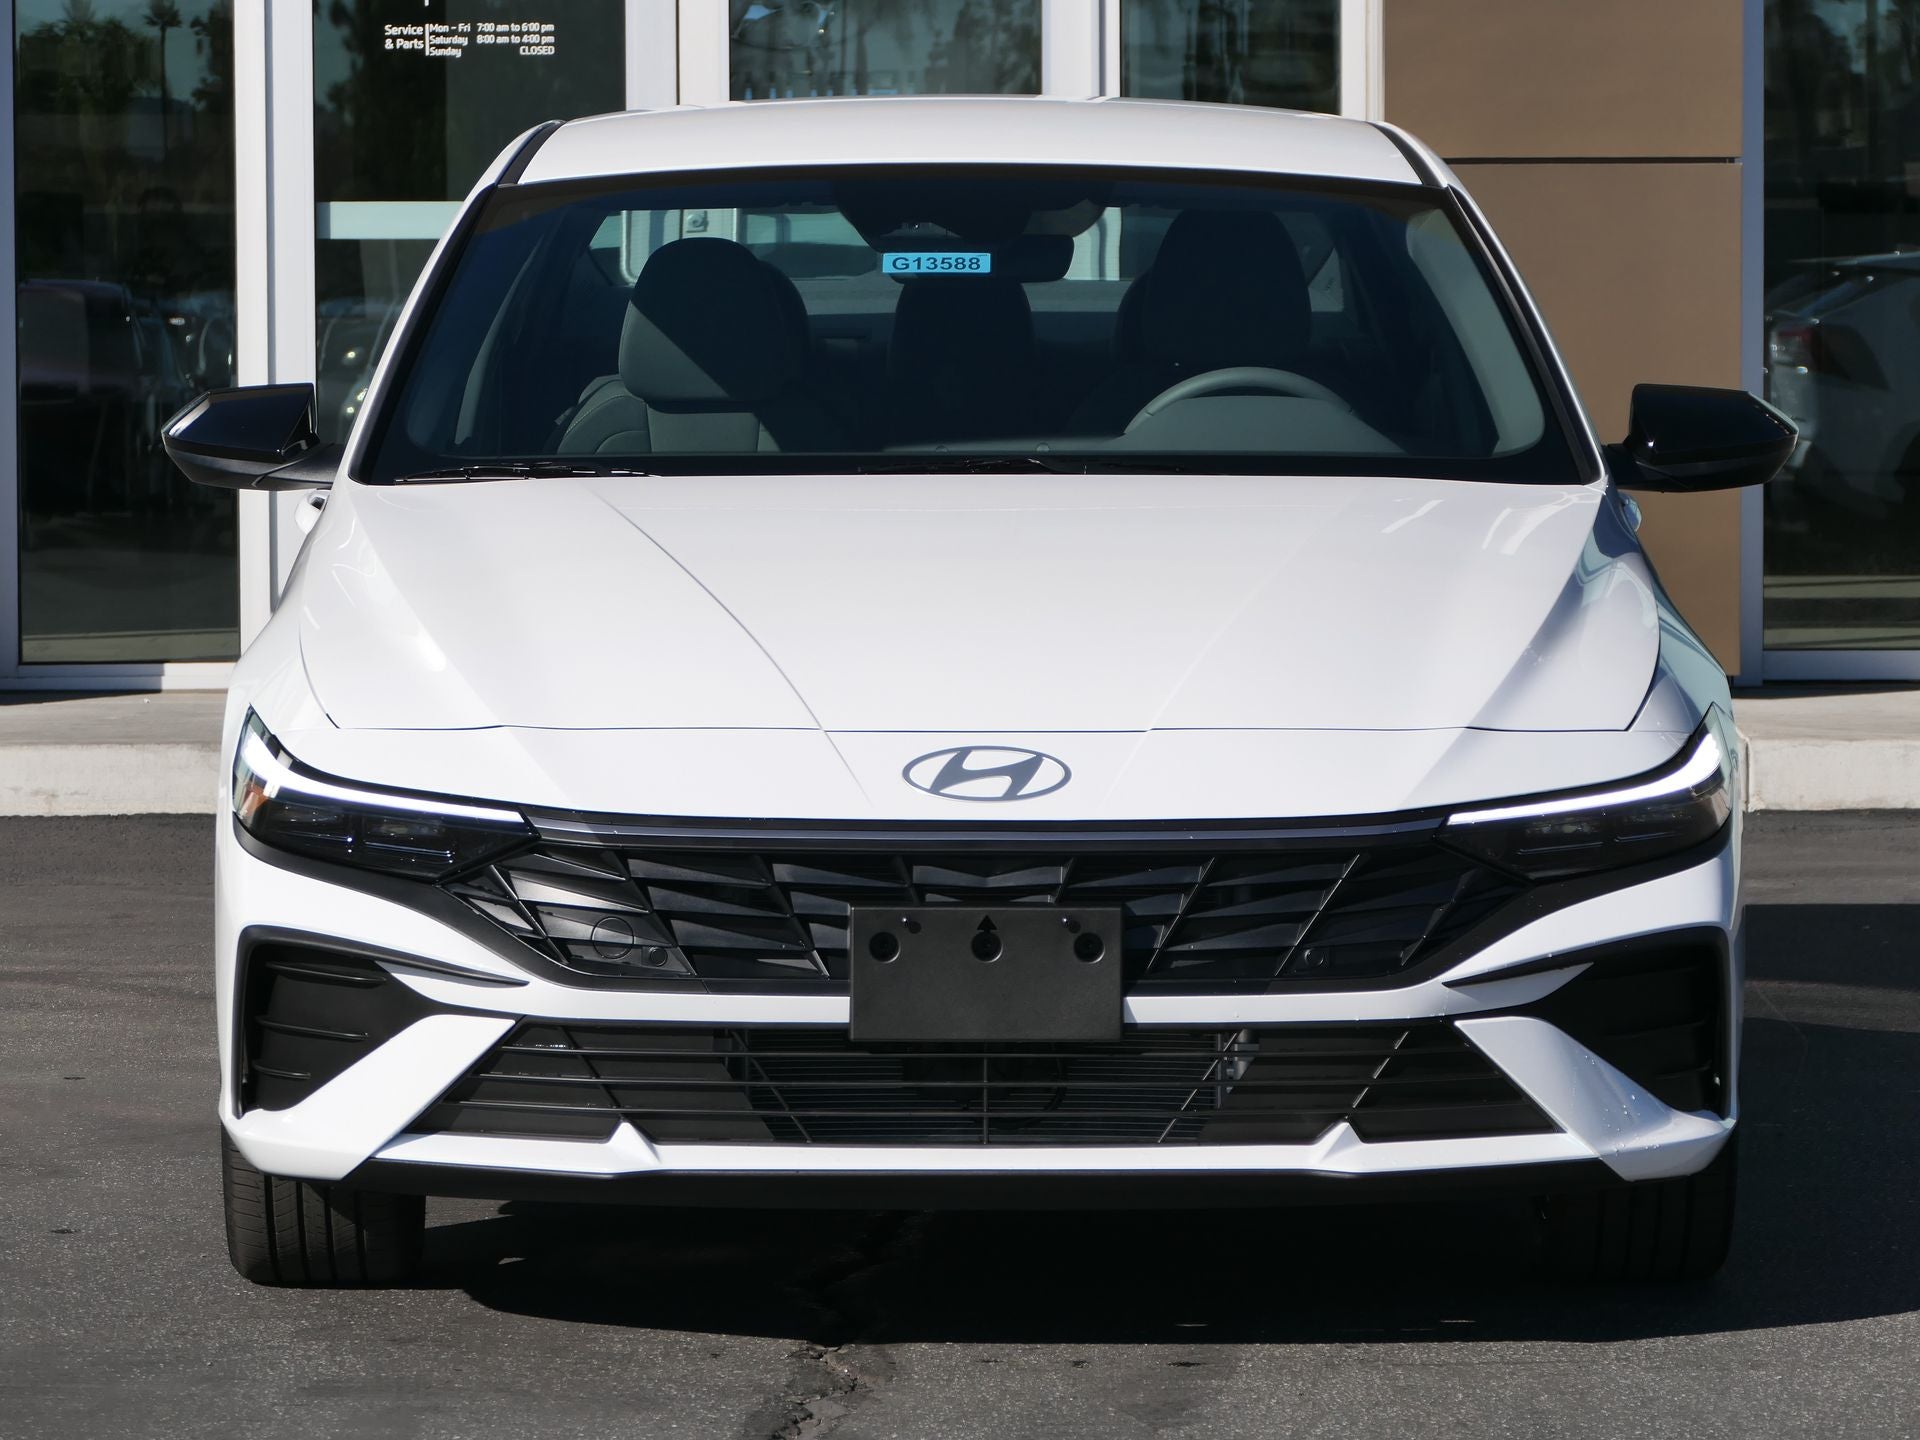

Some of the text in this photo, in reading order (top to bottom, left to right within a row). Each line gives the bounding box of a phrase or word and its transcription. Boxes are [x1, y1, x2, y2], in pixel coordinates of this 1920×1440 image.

[384, 24, 423, 35] Service
[429, 24, 448, 32] Mon
[458, 23, 470, 32] Fri
[477, 22, 495, 32] 7:00
[511, 23, 520, 32] to
[541, 24, 555, 34] pm
[384, 39, 424, 49] & Parts
[429, 34, 555, 46] Saturday 8:00 am to 4:00 pm
[429, 45, 555, 58] Sunday CLOSED
[892, 257, 981, 270] G13588
